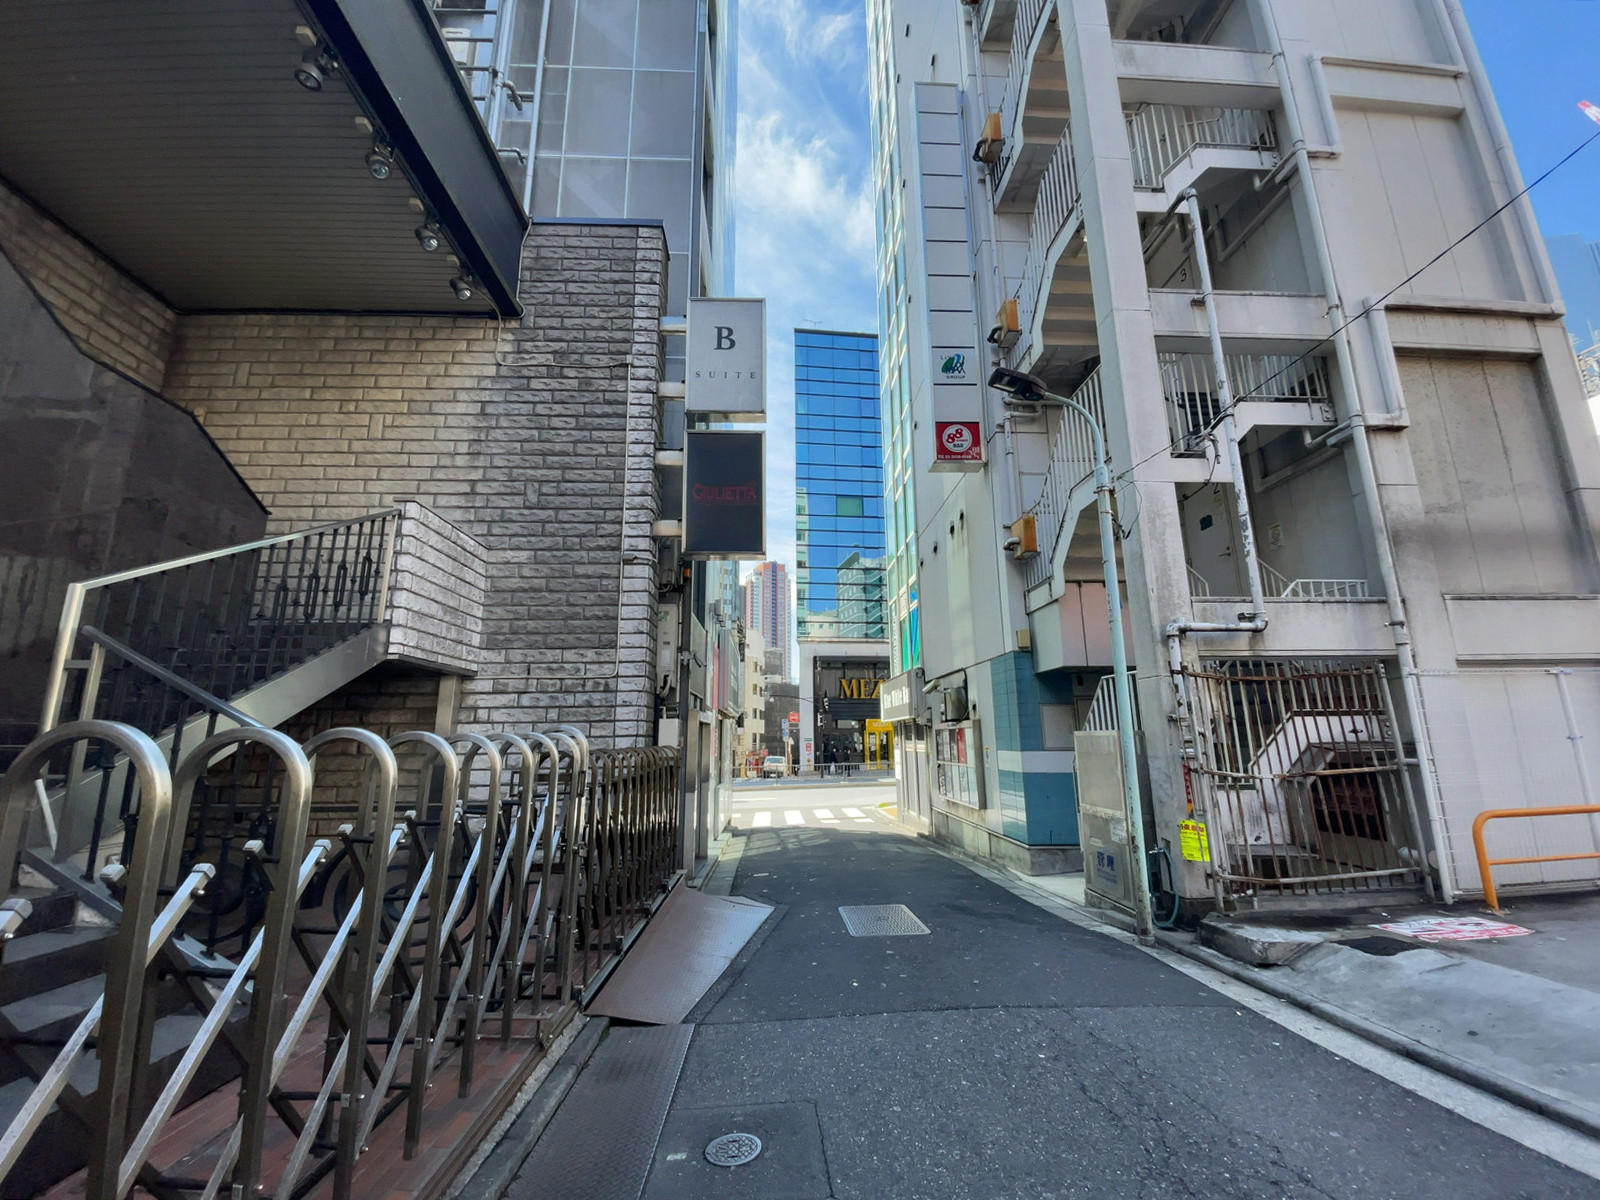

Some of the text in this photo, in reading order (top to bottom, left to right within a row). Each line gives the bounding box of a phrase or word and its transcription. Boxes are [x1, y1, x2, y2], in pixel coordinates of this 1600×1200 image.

[1180, 268, 1187, 282] 3
[714, 326, 736, 350] B
[946, 428, 964, 444] 88
[692, 484, 756, 500] GIULIETTA
